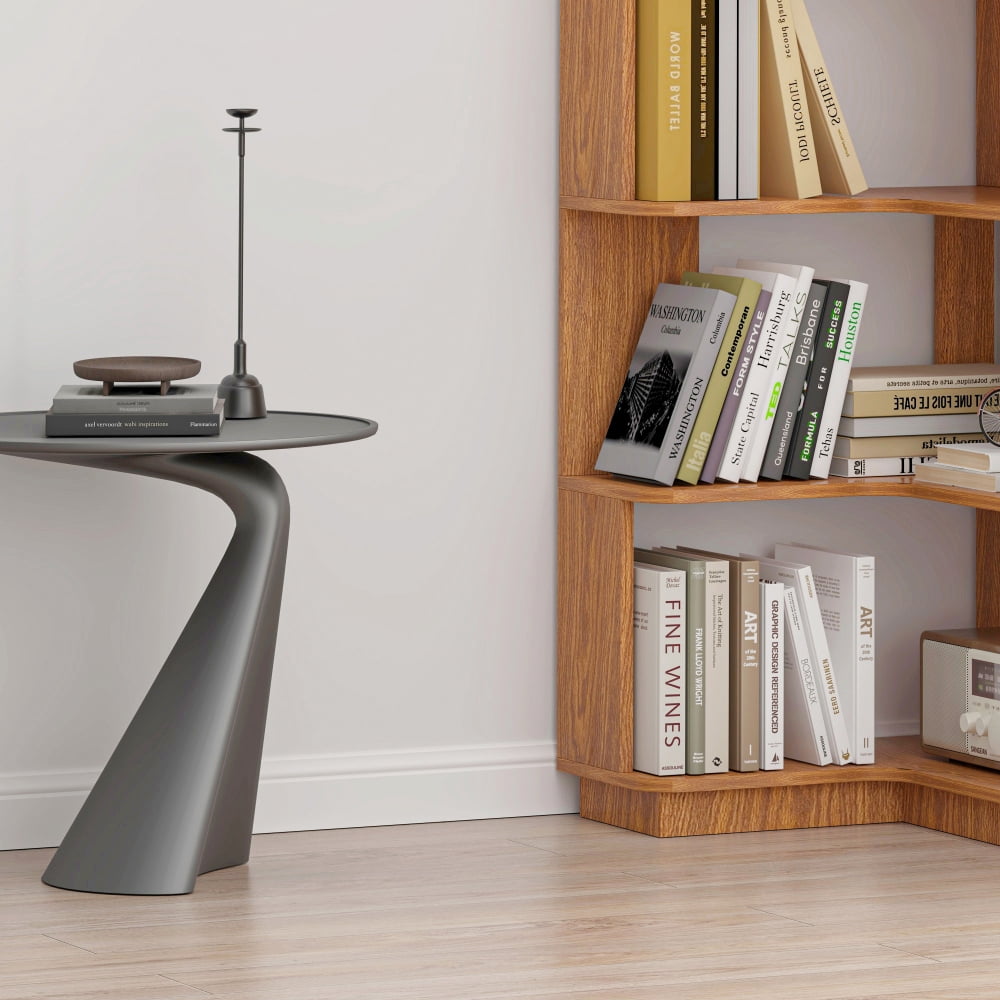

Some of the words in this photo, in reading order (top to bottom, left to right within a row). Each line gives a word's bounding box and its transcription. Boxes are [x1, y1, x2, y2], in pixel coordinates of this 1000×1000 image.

[650, 303, 706, 323] WASHINGTON
[731, 436, 747, 466] State
[740, 392, 760, 433] Capital
[757, 290, 791, 369] Harrisburg
[733, 357, 750, 397] FORM
[746, 310, 765, 354] STYLE
[764, 381, 783, 421] TED
[777, 291, 807, 371] TALKS
[668, 377, 704, 460] WASHINGTON
[709, 311, 726, 345] Columbia
[686, 431, 712, 472] Italia
[721, 306, 750, 377] Contemporan
[774, 411, 793, 466] Queensland
[796, 299, 821, 366] Brisbane
[801, 410, 819, 462] FORMULA
[817, 367, 828, 390] FOR
[826, 299, 843, 349] SUCCESS
[819, 427, 834, 459] Tehas
[838, 302, 862, 363] Houston
[665, 600, 681, 654] FINE
[695, 628, 704, 652] FRANK
[744, 610, 758, 644] ART
[771, 600, 779, 640] GRAPHIC
[860, 606, 873, 638] ART
[695, 652, 704, 676] LLOYD
[771, 642, 779, 674] DESIGN
[801, 658, 817, 704] BORDEAUX
[822, 658, 836, 695] SAARINEN
[664, 665, 681, 748] WINES
[695, 677, 704, 707] WRIGHT
[771, 676, 779, 734] REFERENCED
[831, 697, 840, 715] EERO
